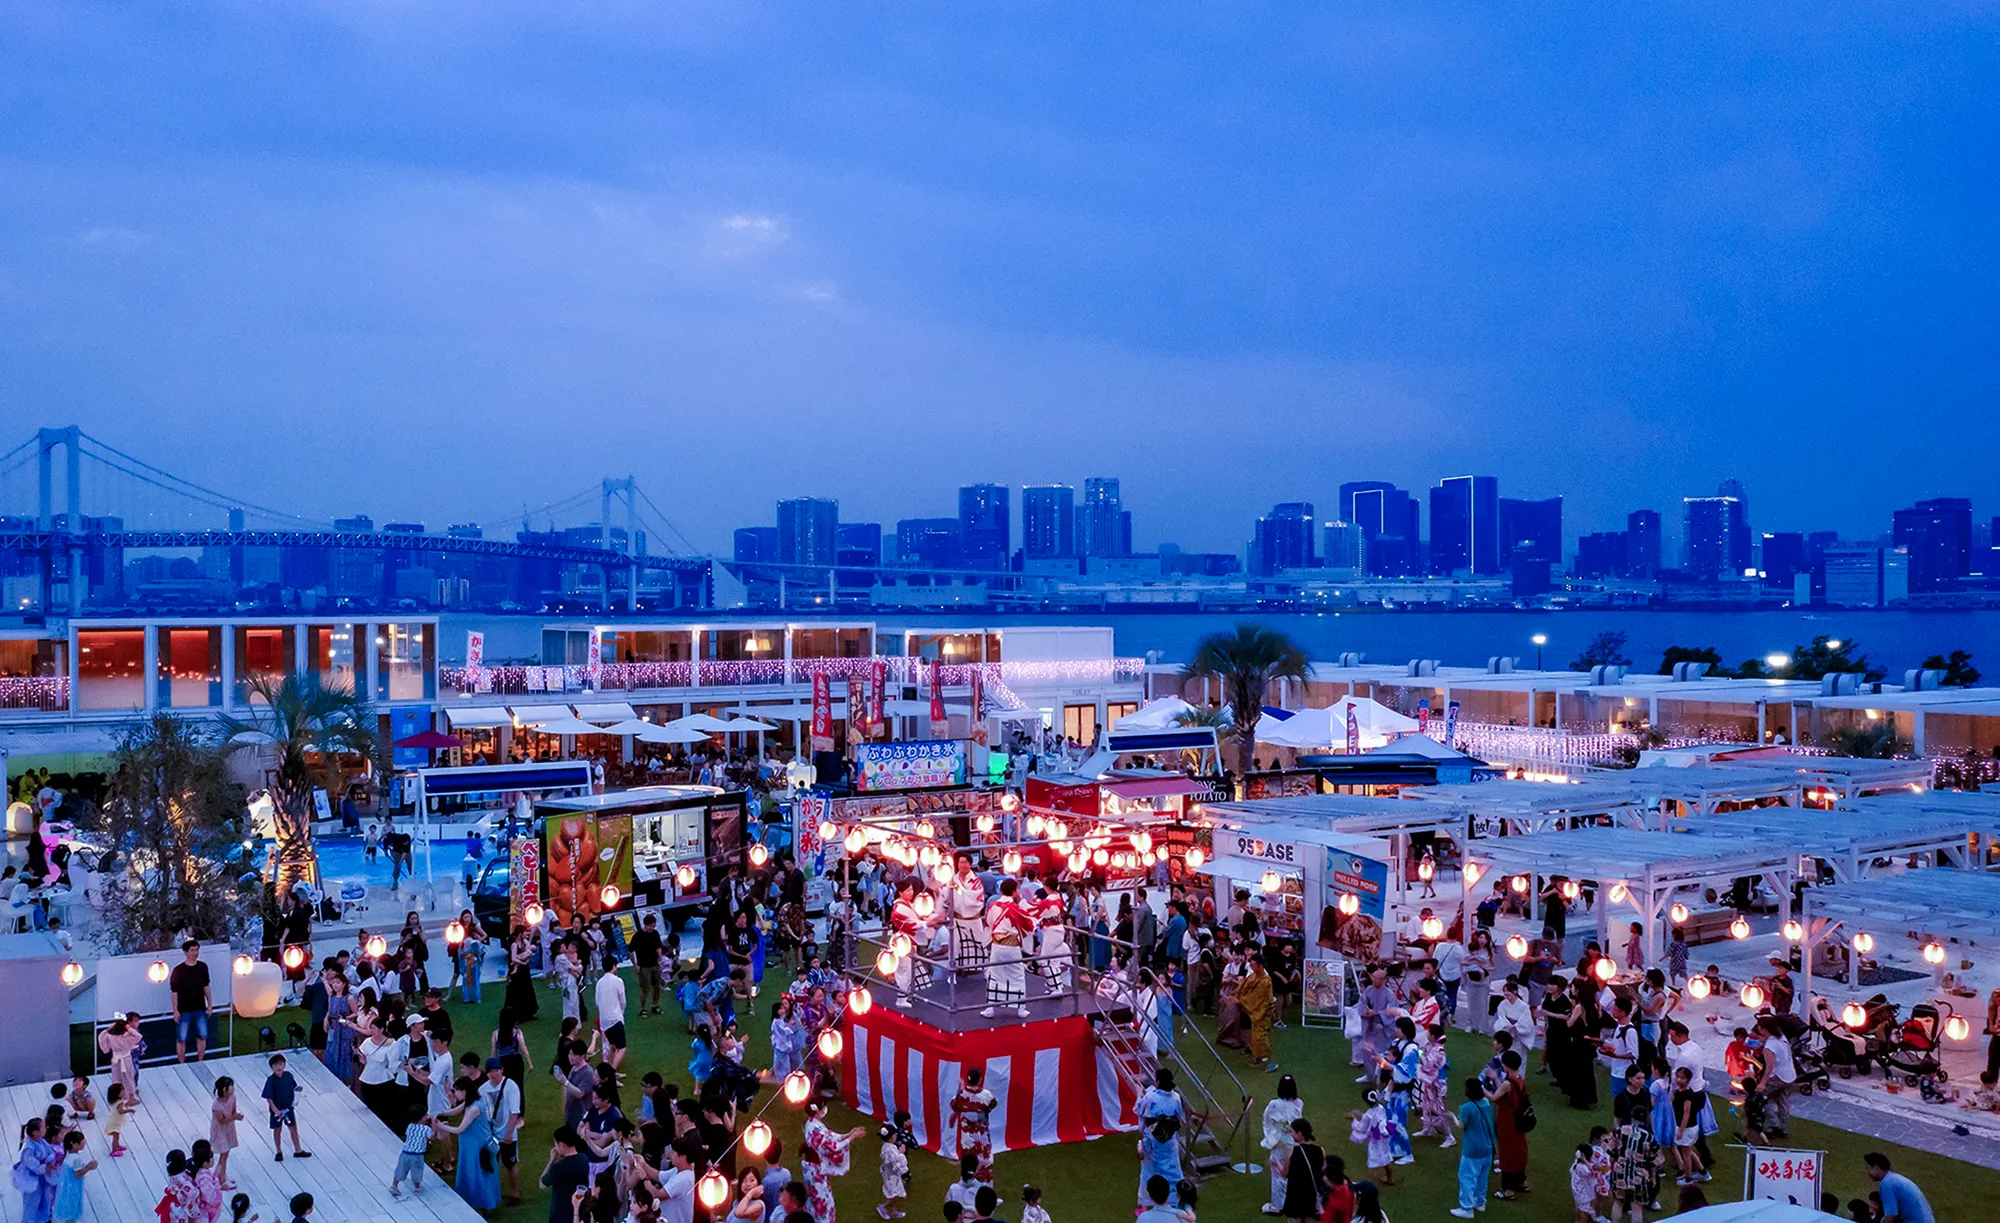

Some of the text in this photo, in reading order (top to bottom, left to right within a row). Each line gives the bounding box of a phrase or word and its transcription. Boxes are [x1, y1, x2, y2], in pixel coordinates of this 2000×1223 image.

[868, 743, 955, 760] ふわふわかき氷
[1189, 791, 1227, 802] POTATO
[1238, 838, 1294, 862] 95BASE
[1335, 873, 1359, 887] PULLED
[1360, 880, 1378, 892] PORK
[1758, 1158, 1816, 1181] 味自慢
